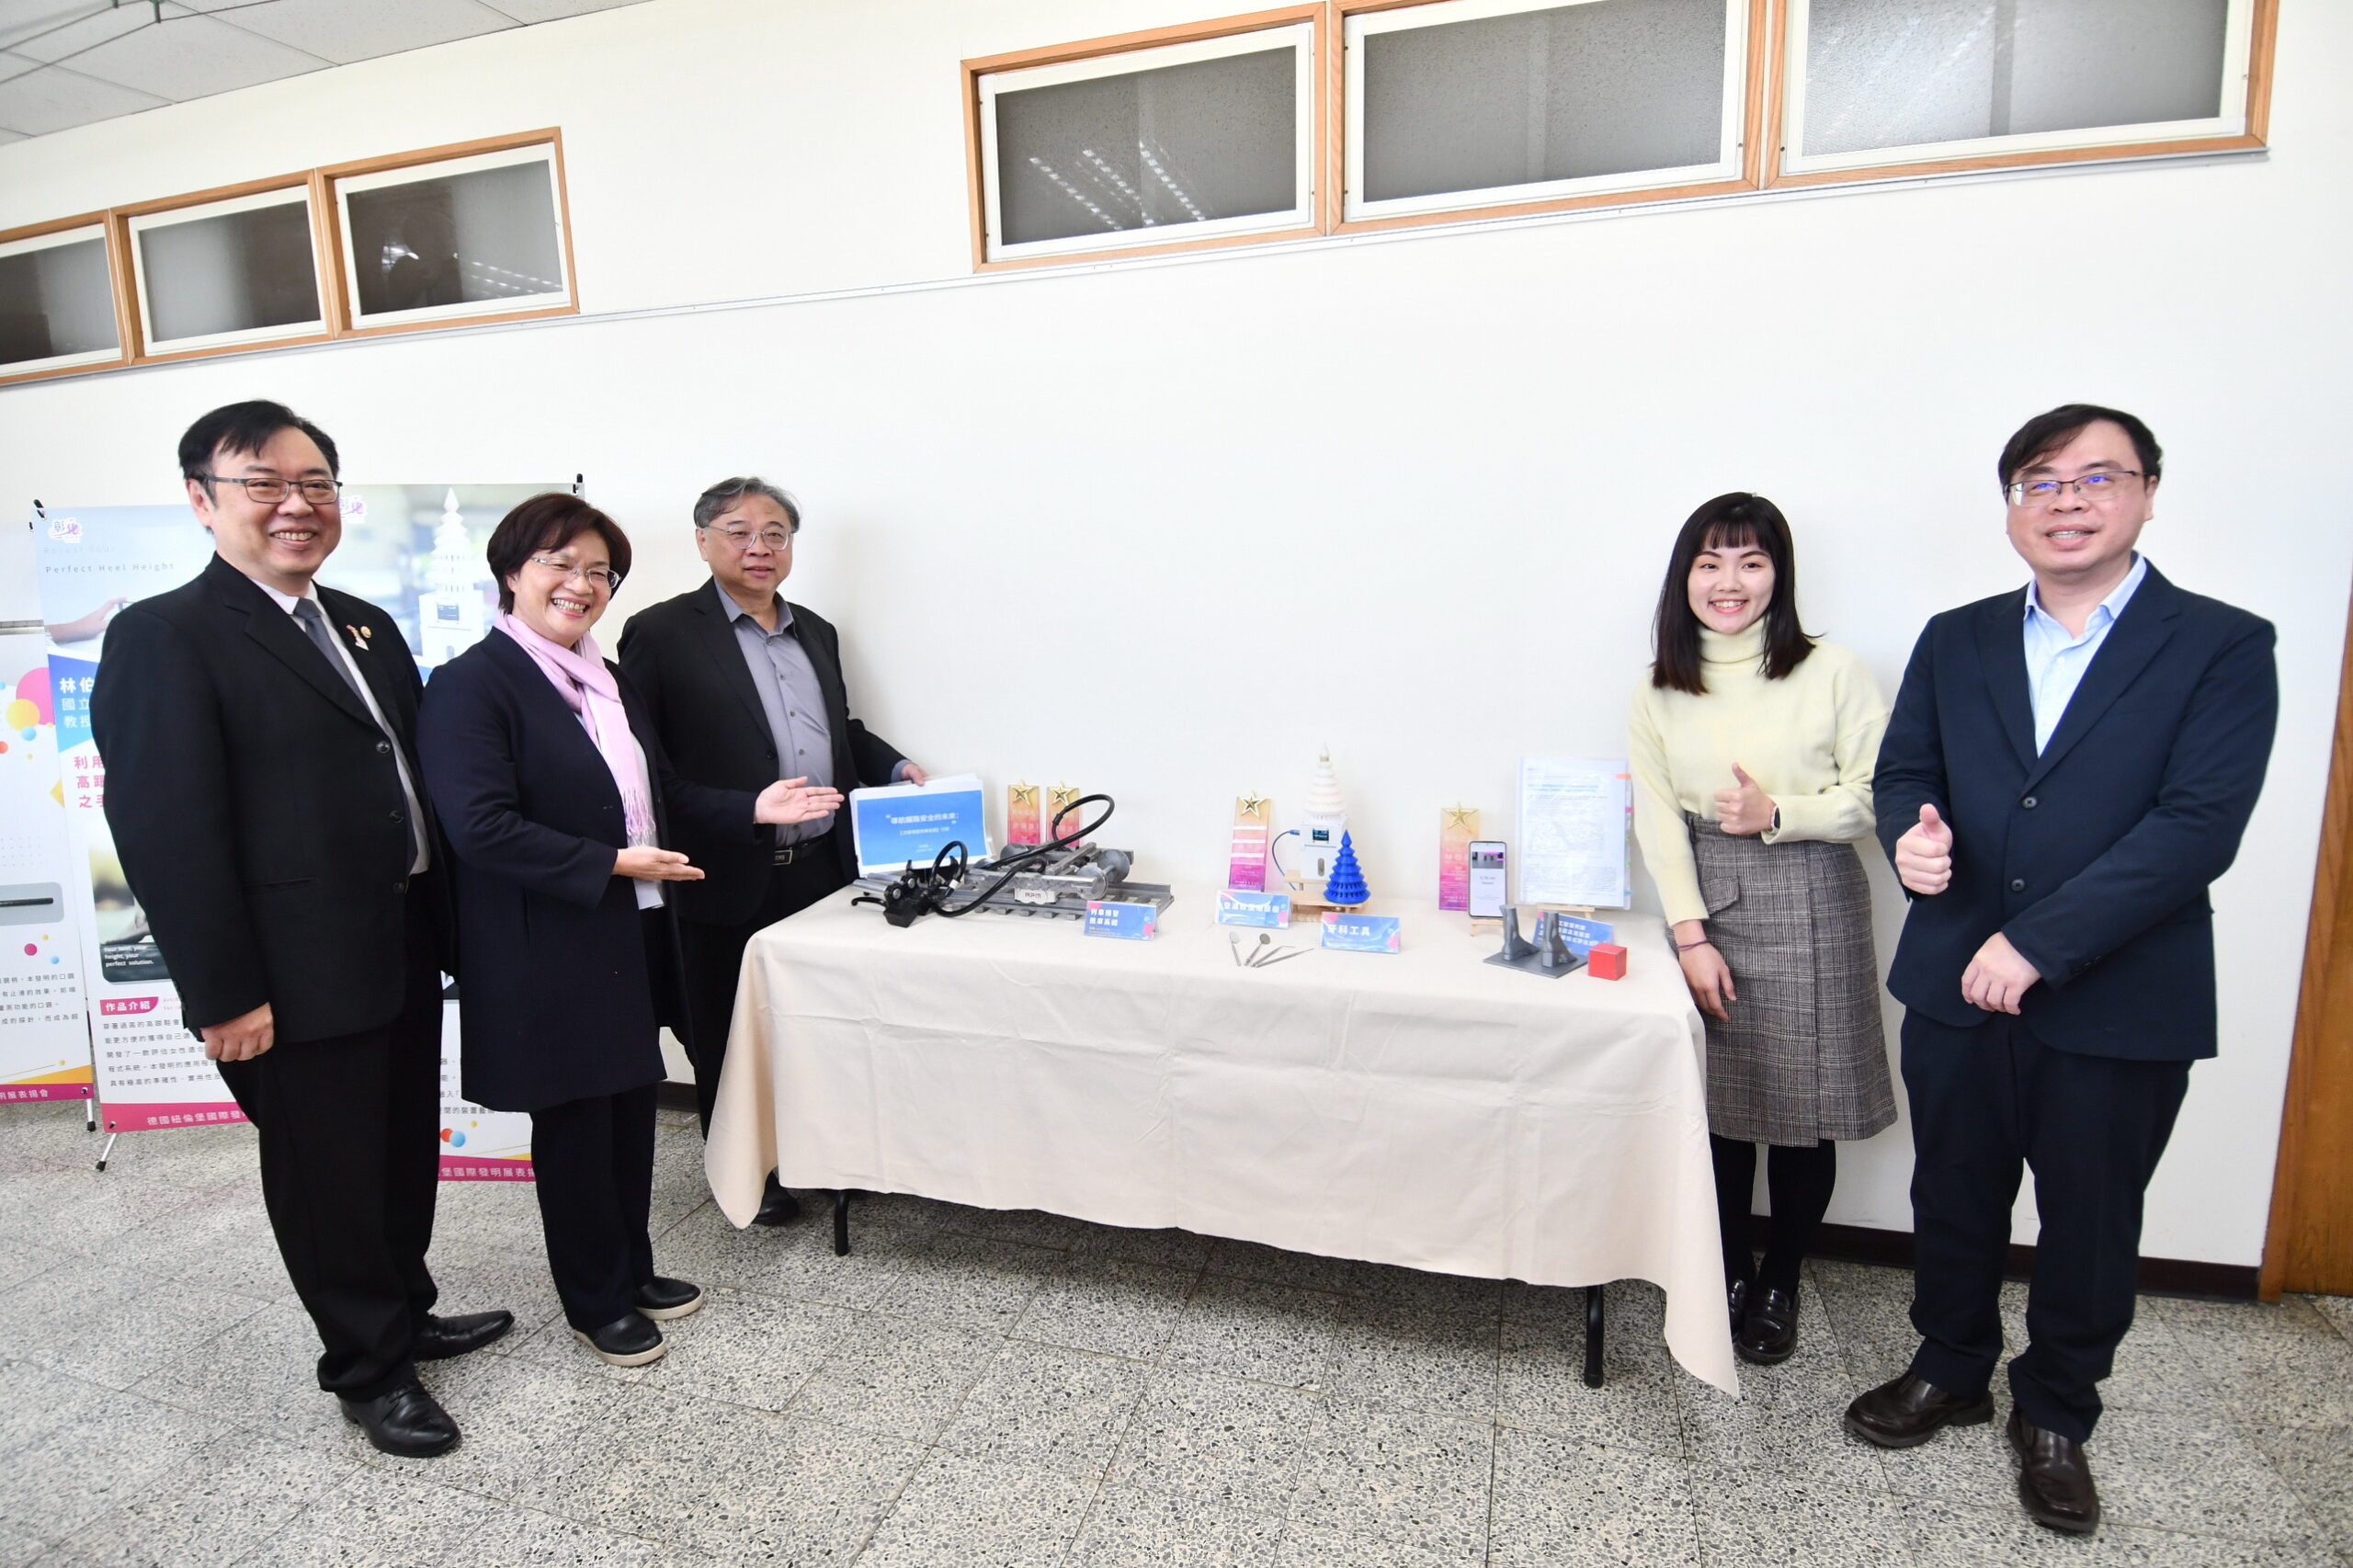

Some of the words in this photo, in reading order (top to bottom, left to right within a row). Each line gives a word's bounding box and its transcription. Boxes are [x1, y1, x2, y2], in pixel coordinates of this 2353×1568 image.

[46, 564, 92, 574] Perfect
[99, 563, 126, 572] Heel
[132, 562, 175, 572] Height
[1327, 924, 1371, 936] 牙科工具
[106, 1001, 151, 1012] 作品介紹
[147, 1110, 246, 1126] 德國紐倫堡國際發
